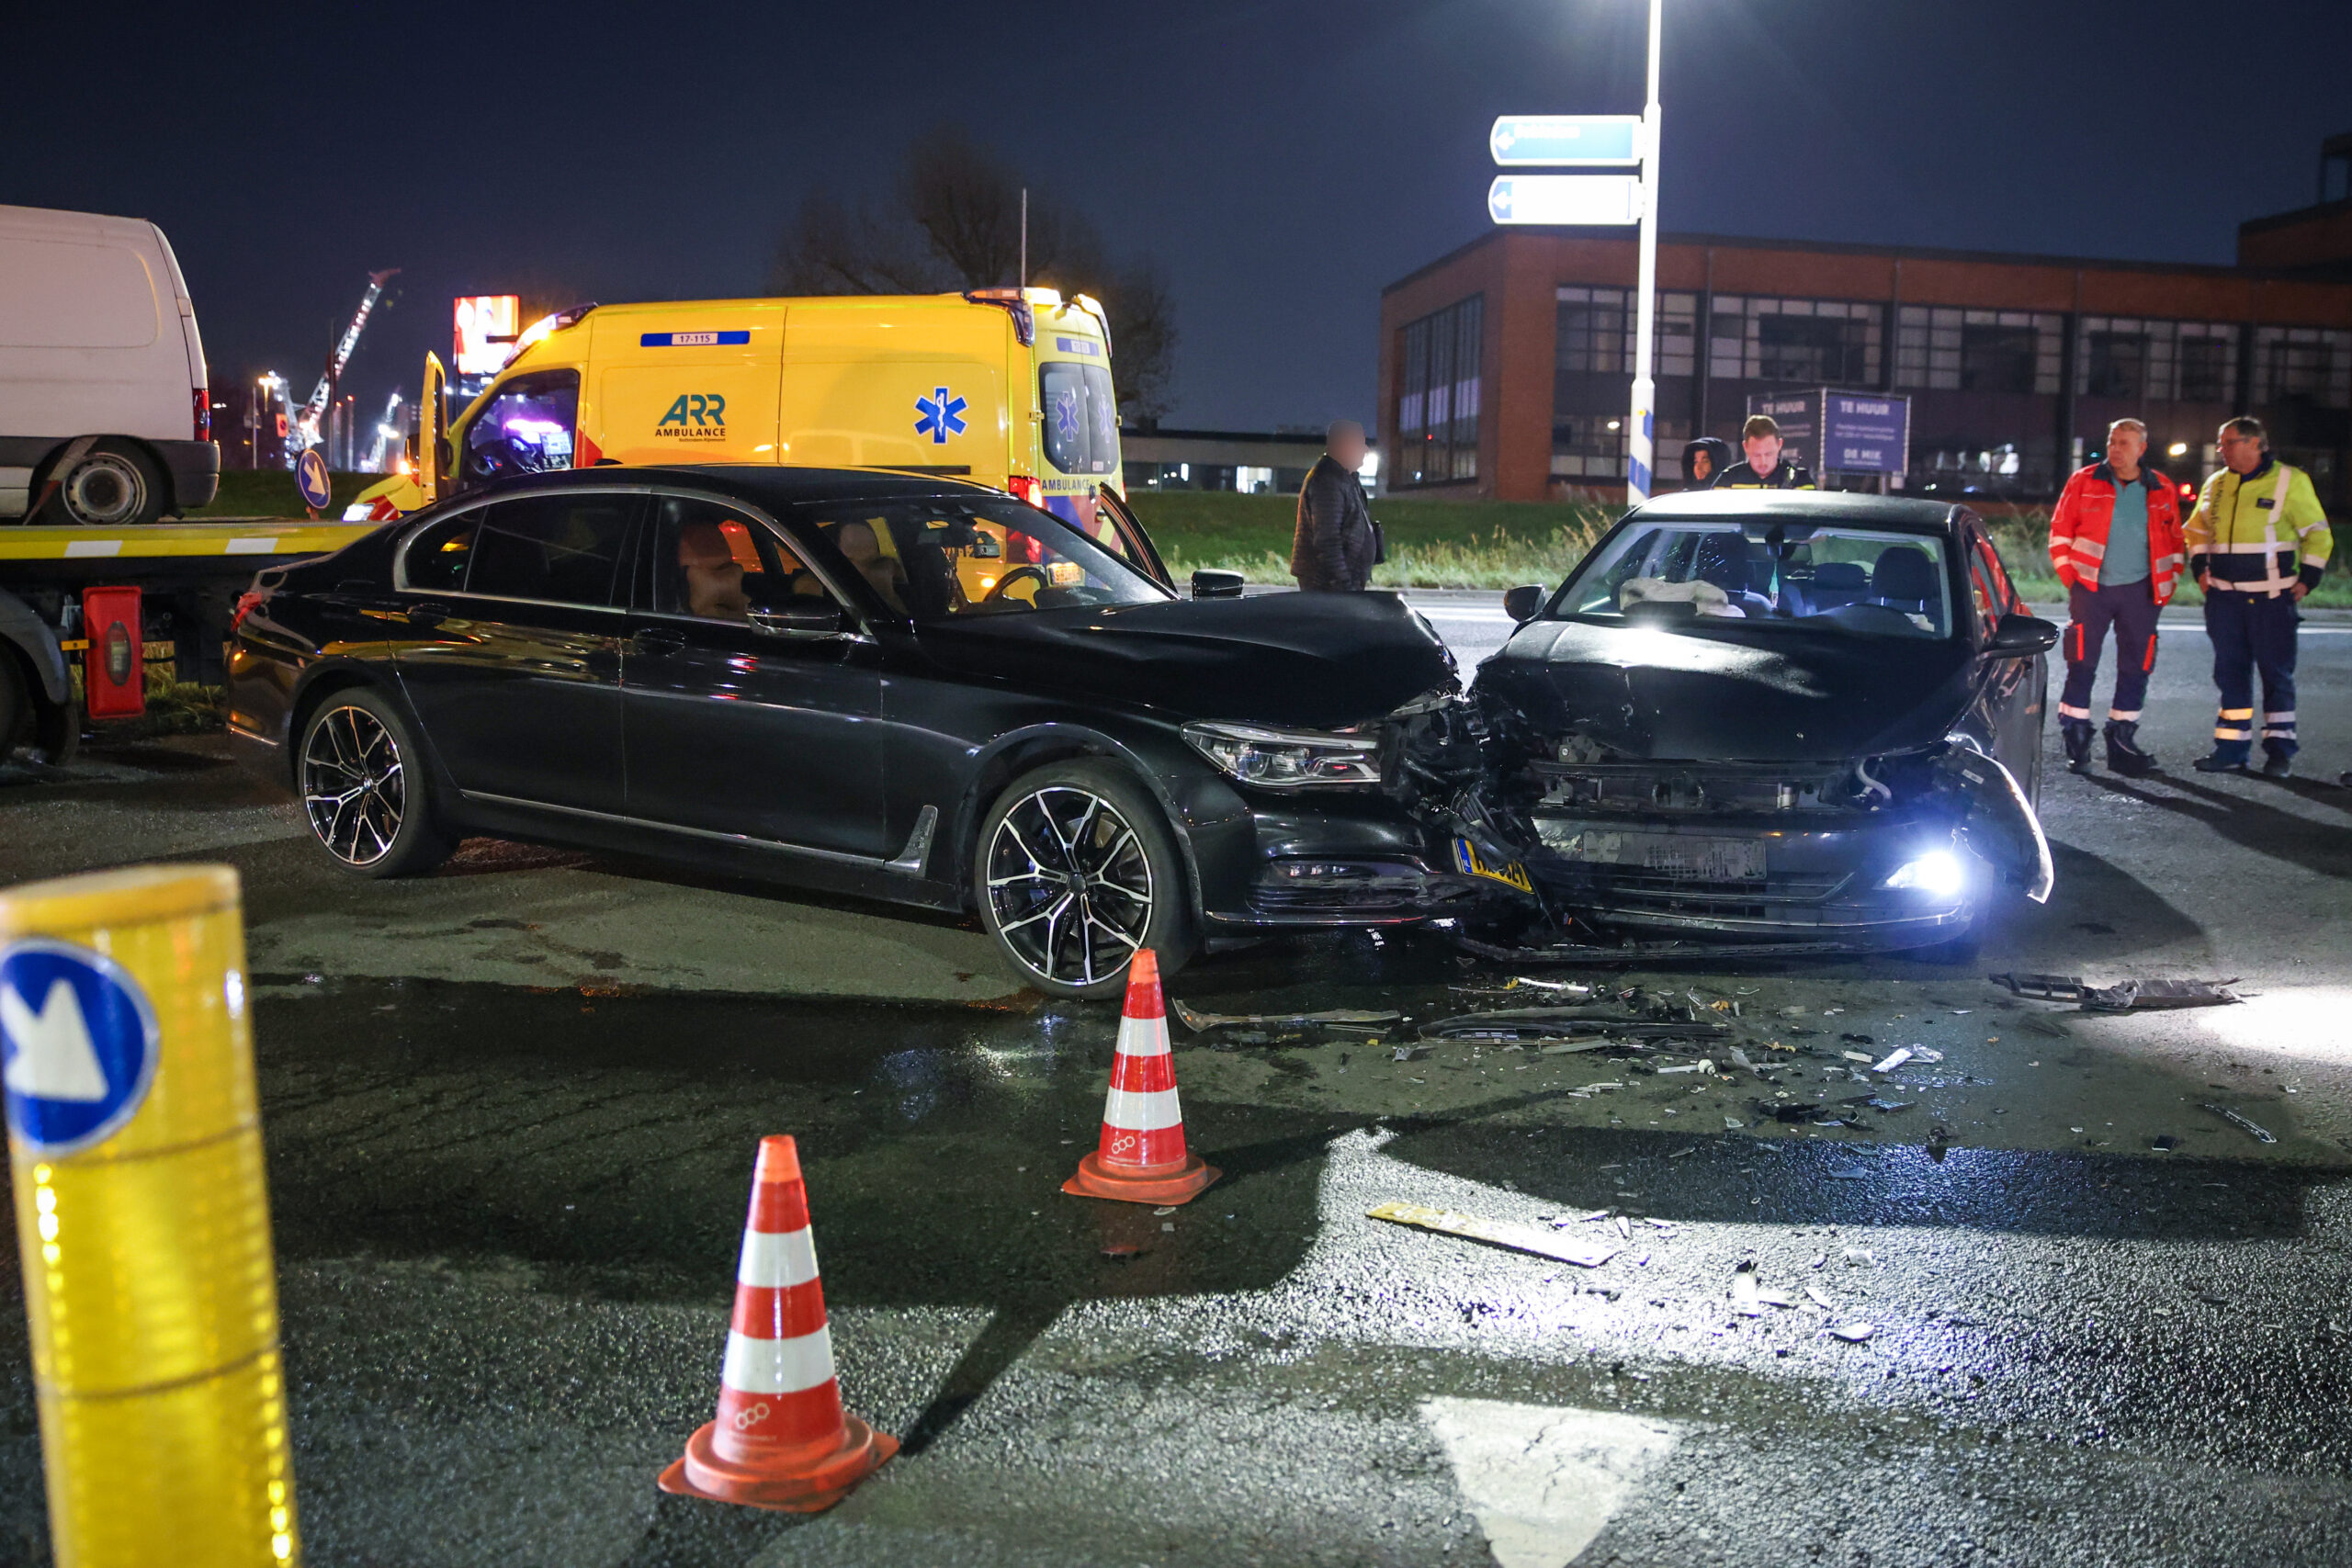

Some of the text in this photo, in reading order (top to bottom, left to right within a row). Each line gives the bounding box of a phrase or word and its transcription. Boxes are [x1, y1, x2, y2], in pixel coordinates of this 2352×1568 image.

[680, 334, 710, 343] 17-115
[659, 394, 725, 425] ARR
[1762, 401, 1804, 414] TE HUUR
[1841, 400, 1889, 415] TE HUUR
[655, 428, 726, 436] AMBULANCE
[1042, 479, 1091, 491] AMBULANCE
